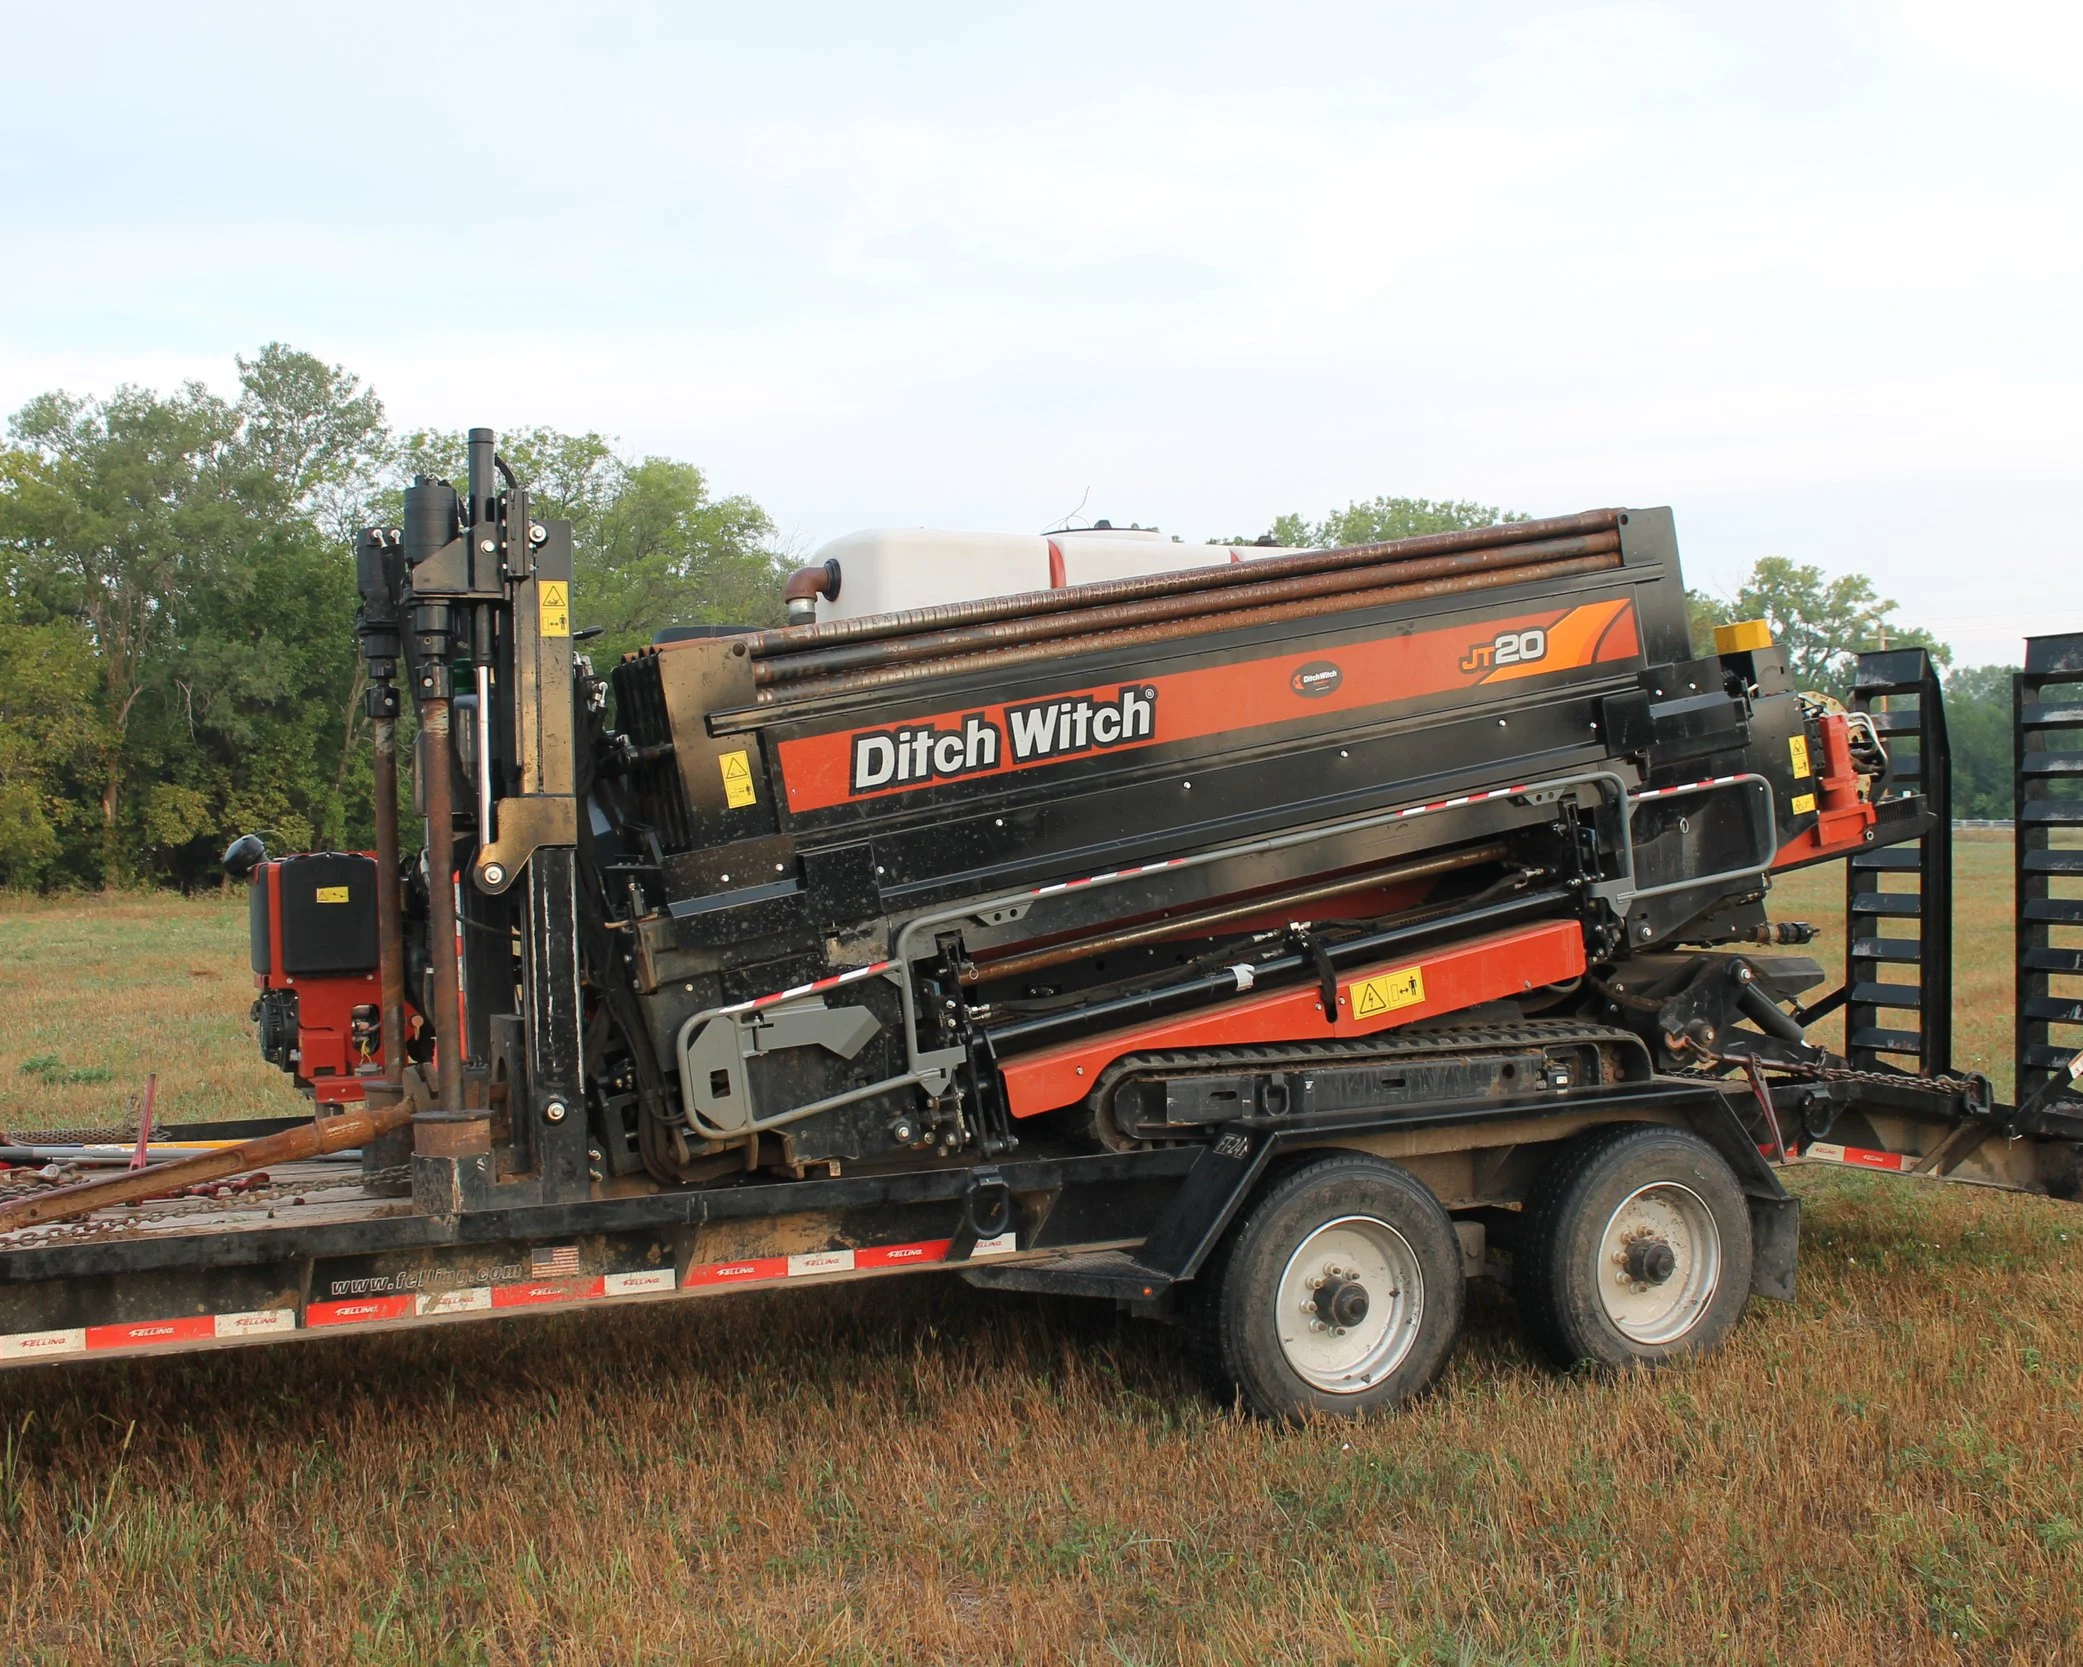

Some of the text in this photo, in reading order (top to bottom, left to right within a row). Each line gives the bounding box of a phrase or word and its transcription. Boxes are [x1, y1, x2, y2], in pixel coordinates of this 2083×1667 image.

[1462, 630, 1545, 670] JT20
[1303, 673, 1320, 684] Ditch
[855, 718, 996, 789] Ditch
[975, 1240, 1002, 1248] ELLING
[886, 1248, 923, 1258] FELLING
[803, 1257, 840, 1267] FELLING
[717, 1267, 755, 1277] FELLING
[622, 1277, 660, 1287] FELLING
[334, 1305, 379, 1316] FELLING
[234, 1317, 278, 1327] FELLING
[128, 1327, 175, 1338] FELLING
[19, 1337, 66, 1348] FELLING
